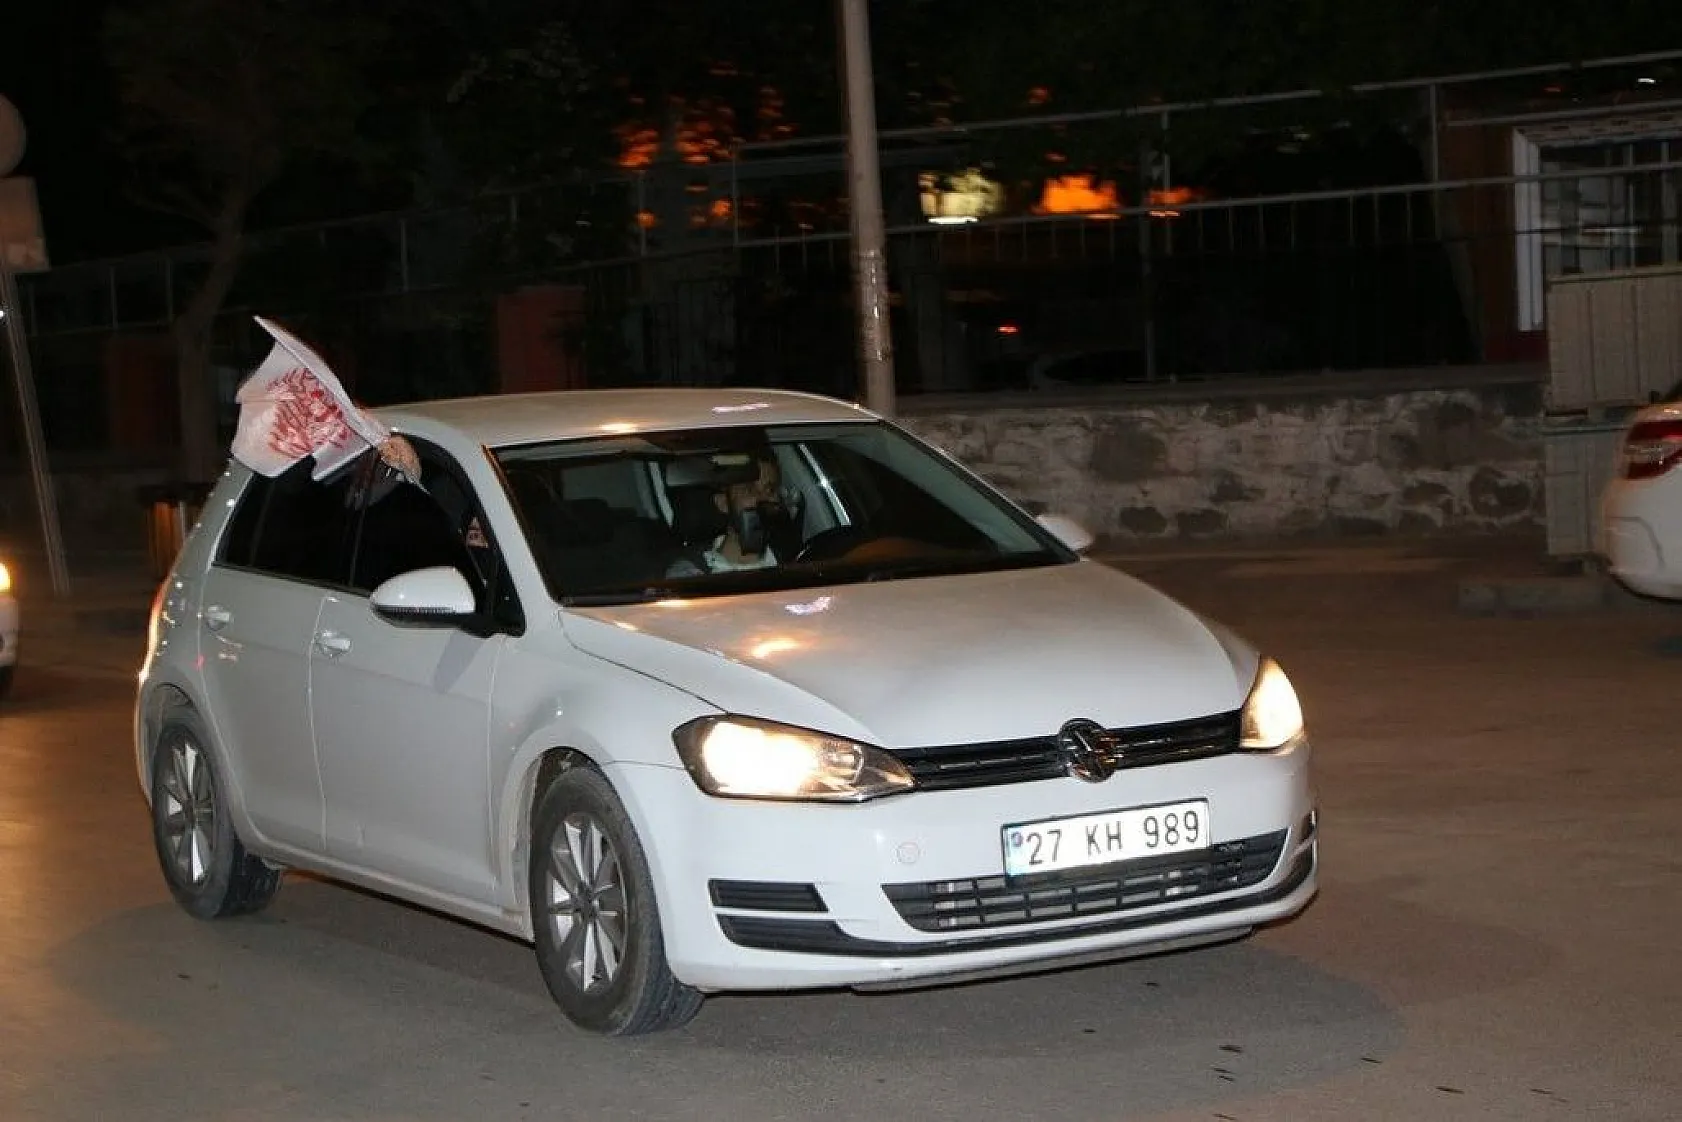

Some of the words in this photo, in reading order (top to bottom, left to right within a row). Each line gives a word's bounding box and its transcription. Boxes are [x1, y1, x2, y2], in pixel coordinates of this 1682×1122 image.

[1026, 828, 1062, 865] 27
[1085, 820, 1123, 856] KH
[1143, 810, 1199, 848] 989
